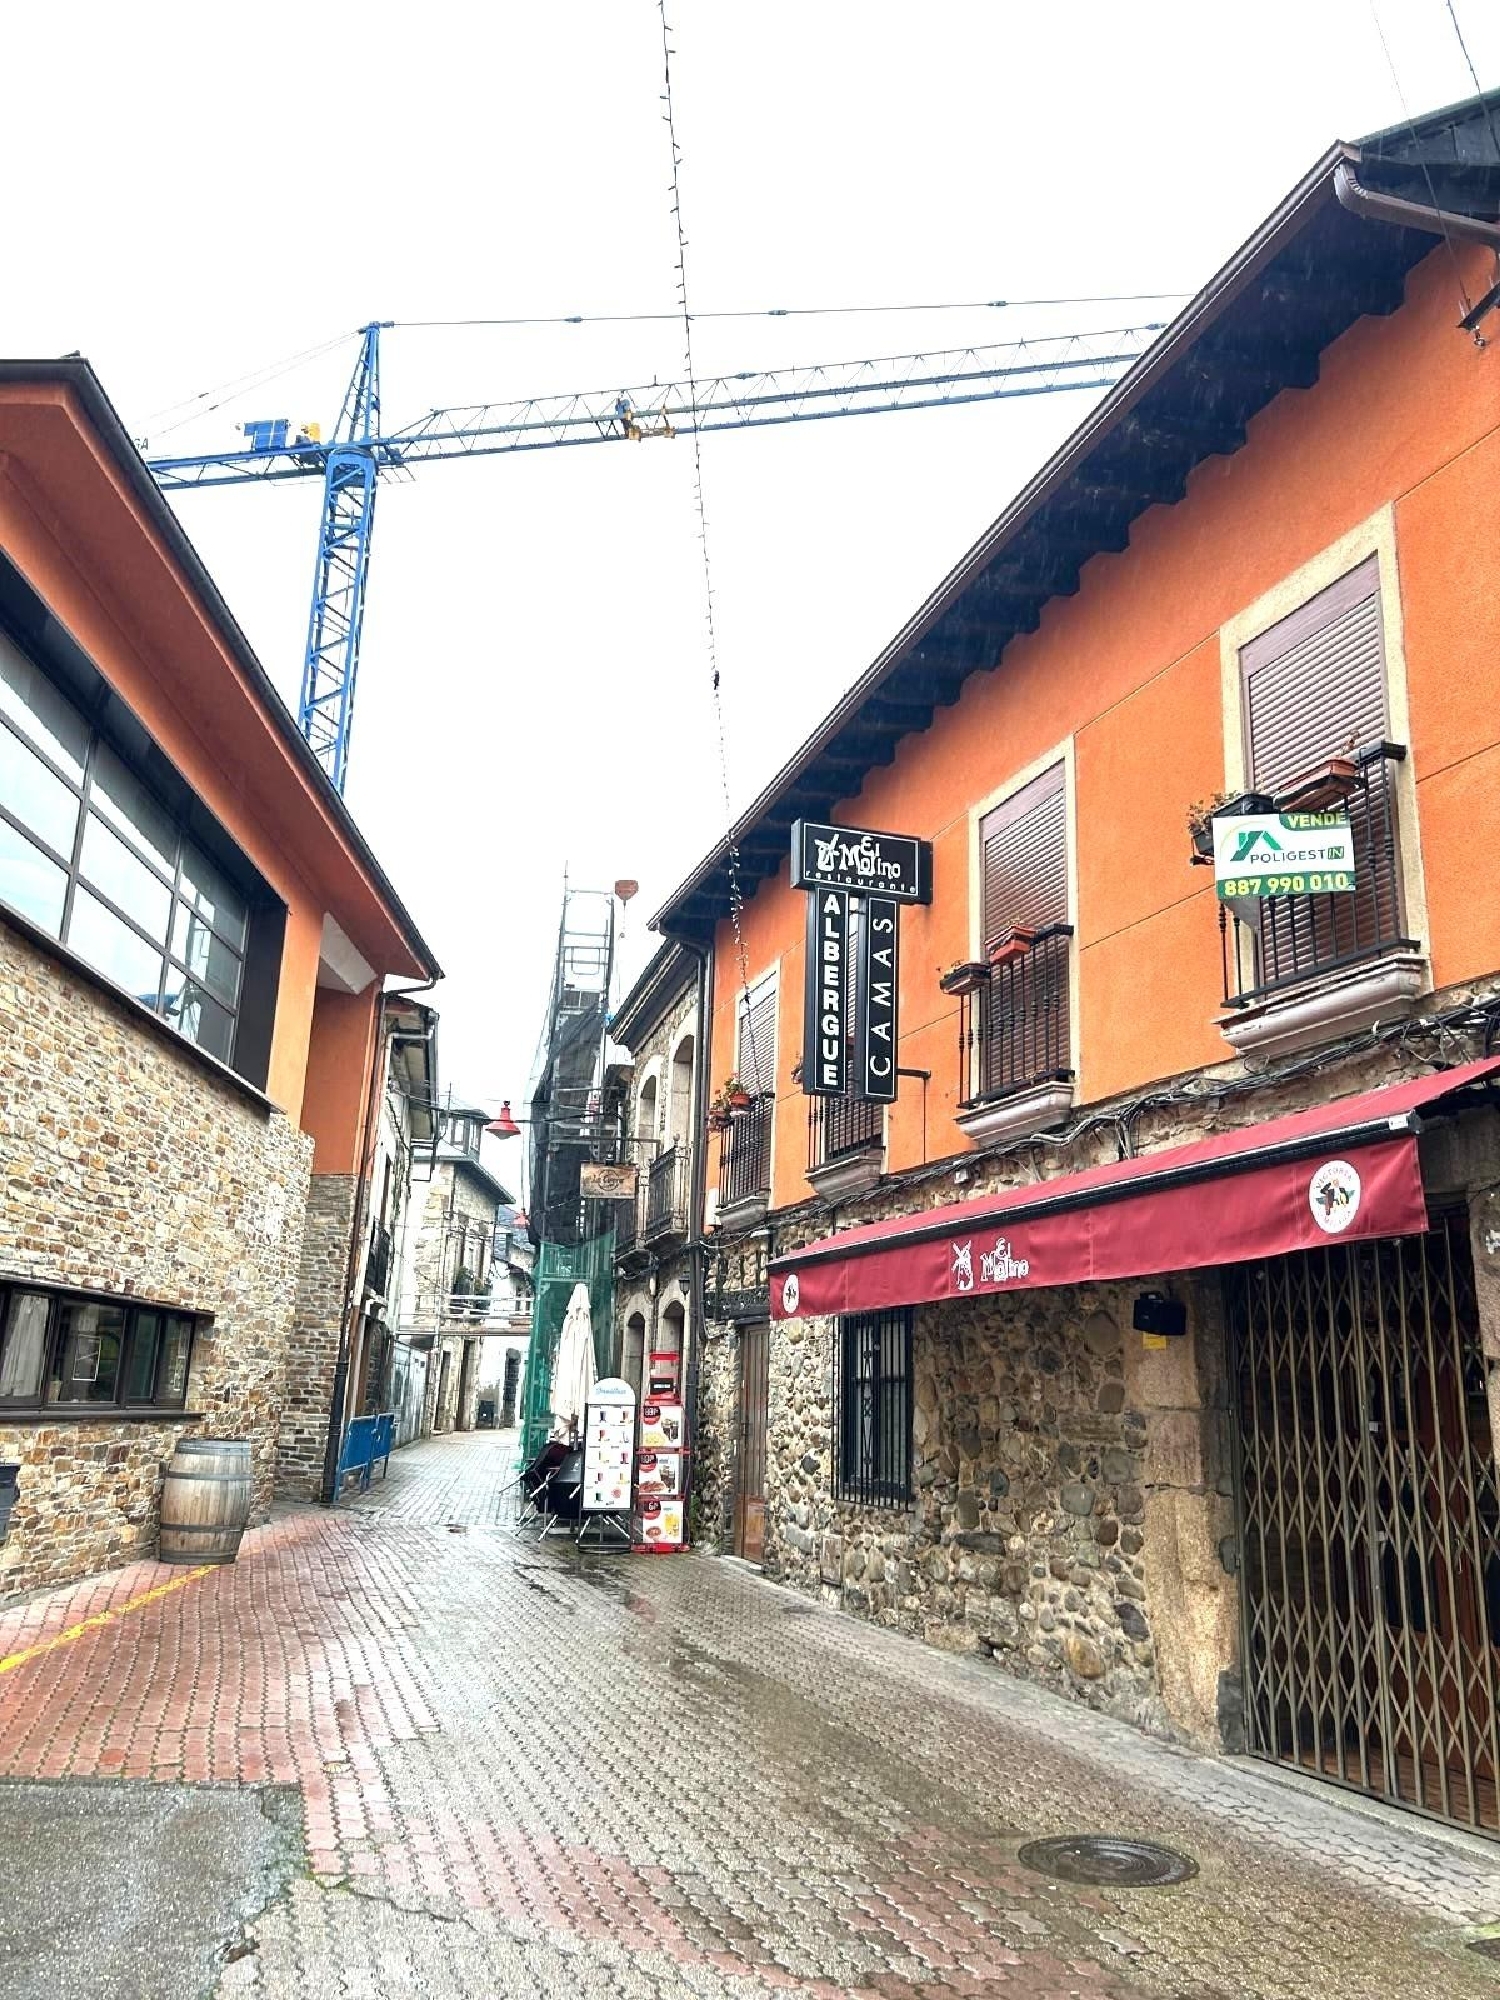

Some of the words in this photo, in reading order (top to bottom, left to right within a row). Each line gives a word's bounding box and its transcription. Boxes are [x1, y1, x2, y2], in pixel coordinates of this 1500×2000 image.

[1287, 813, 1347, 829] VENDE
[860, 835, 881, 857] El
[1250, 846, 1345, 864] POLIGESTIN
[838, 843, 902, 880] Molino
[1224, 878, 1262, 896] 887
[1267, 875, 1305, 894] 990
[1309, 872, 1348, 891] 010
[822, 893, 841, 1086] ALBERGUE
[869, 918, 894, 1077] CAMAS
